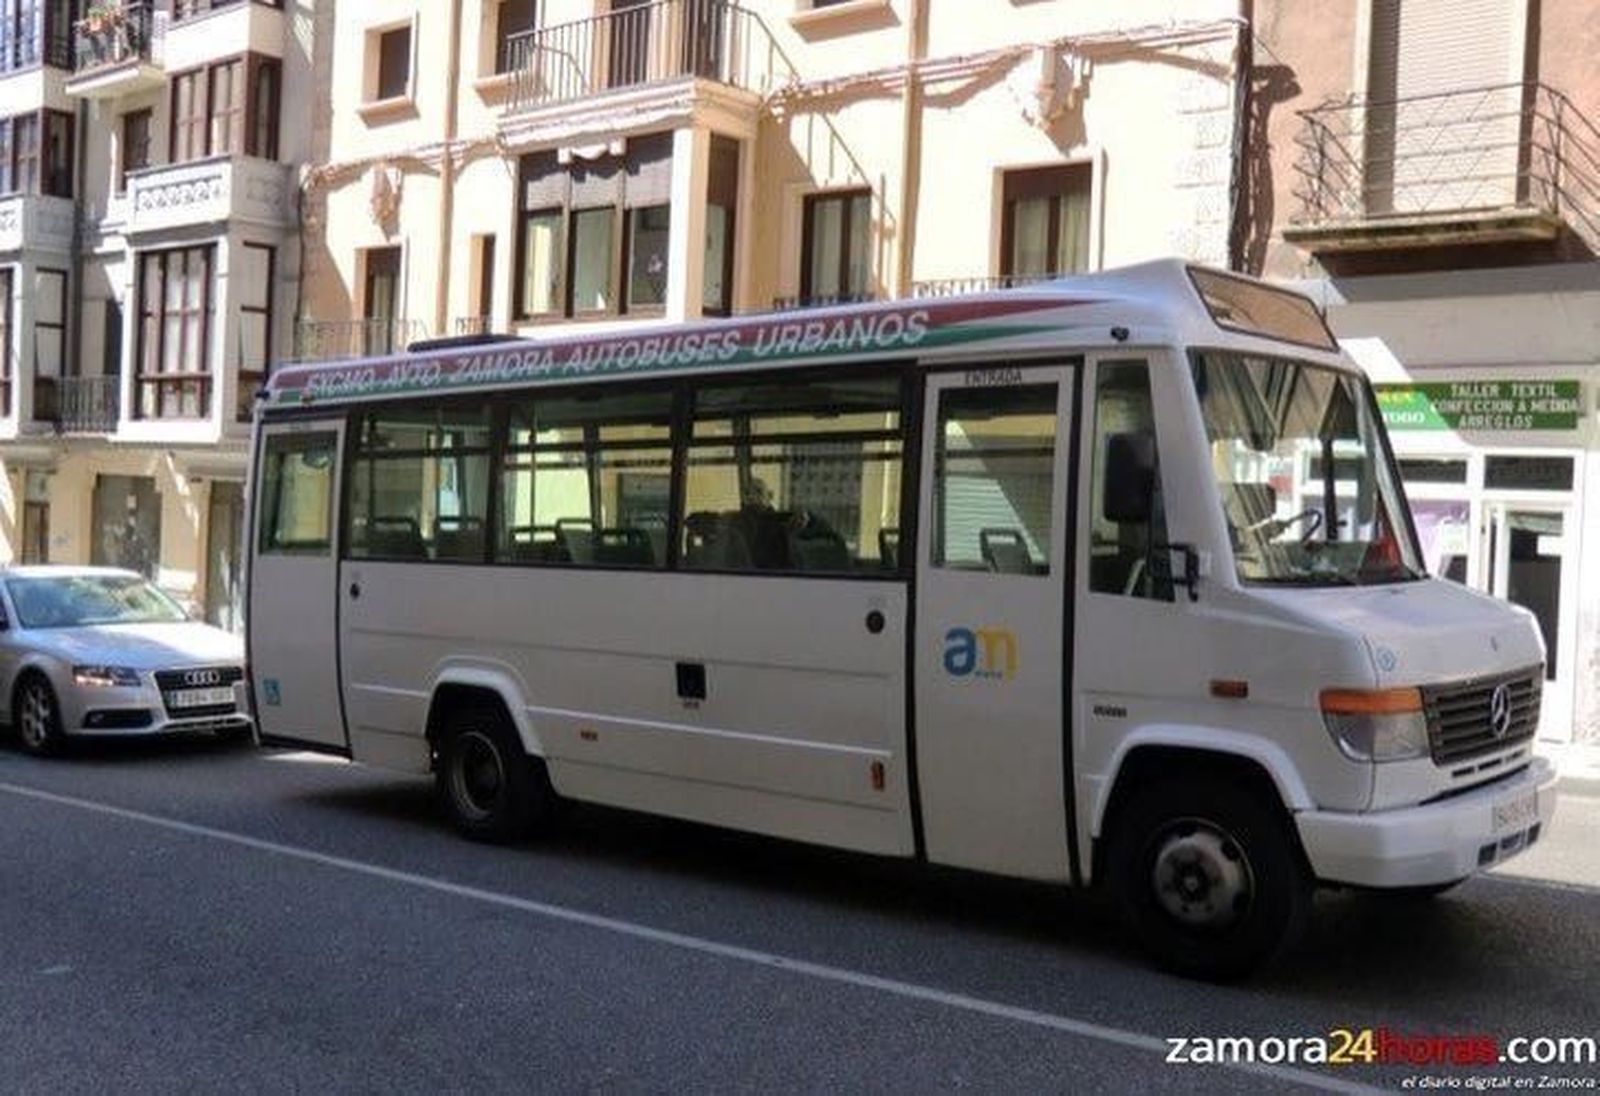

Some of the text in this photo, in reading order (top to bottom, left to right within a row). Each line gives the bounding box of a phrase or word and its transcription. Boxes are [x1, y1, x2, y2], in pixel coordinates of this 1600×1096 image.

[450, 346, 552, 382] ZAMORA
[562, 330, 741, 374] AUTOBUSES
[752, 310, 929, 357] URBANOS
[1451, 383, 1557, 398] TALLER TEXTIL
[1458, 414, 1534, 430] ARREGLOS
